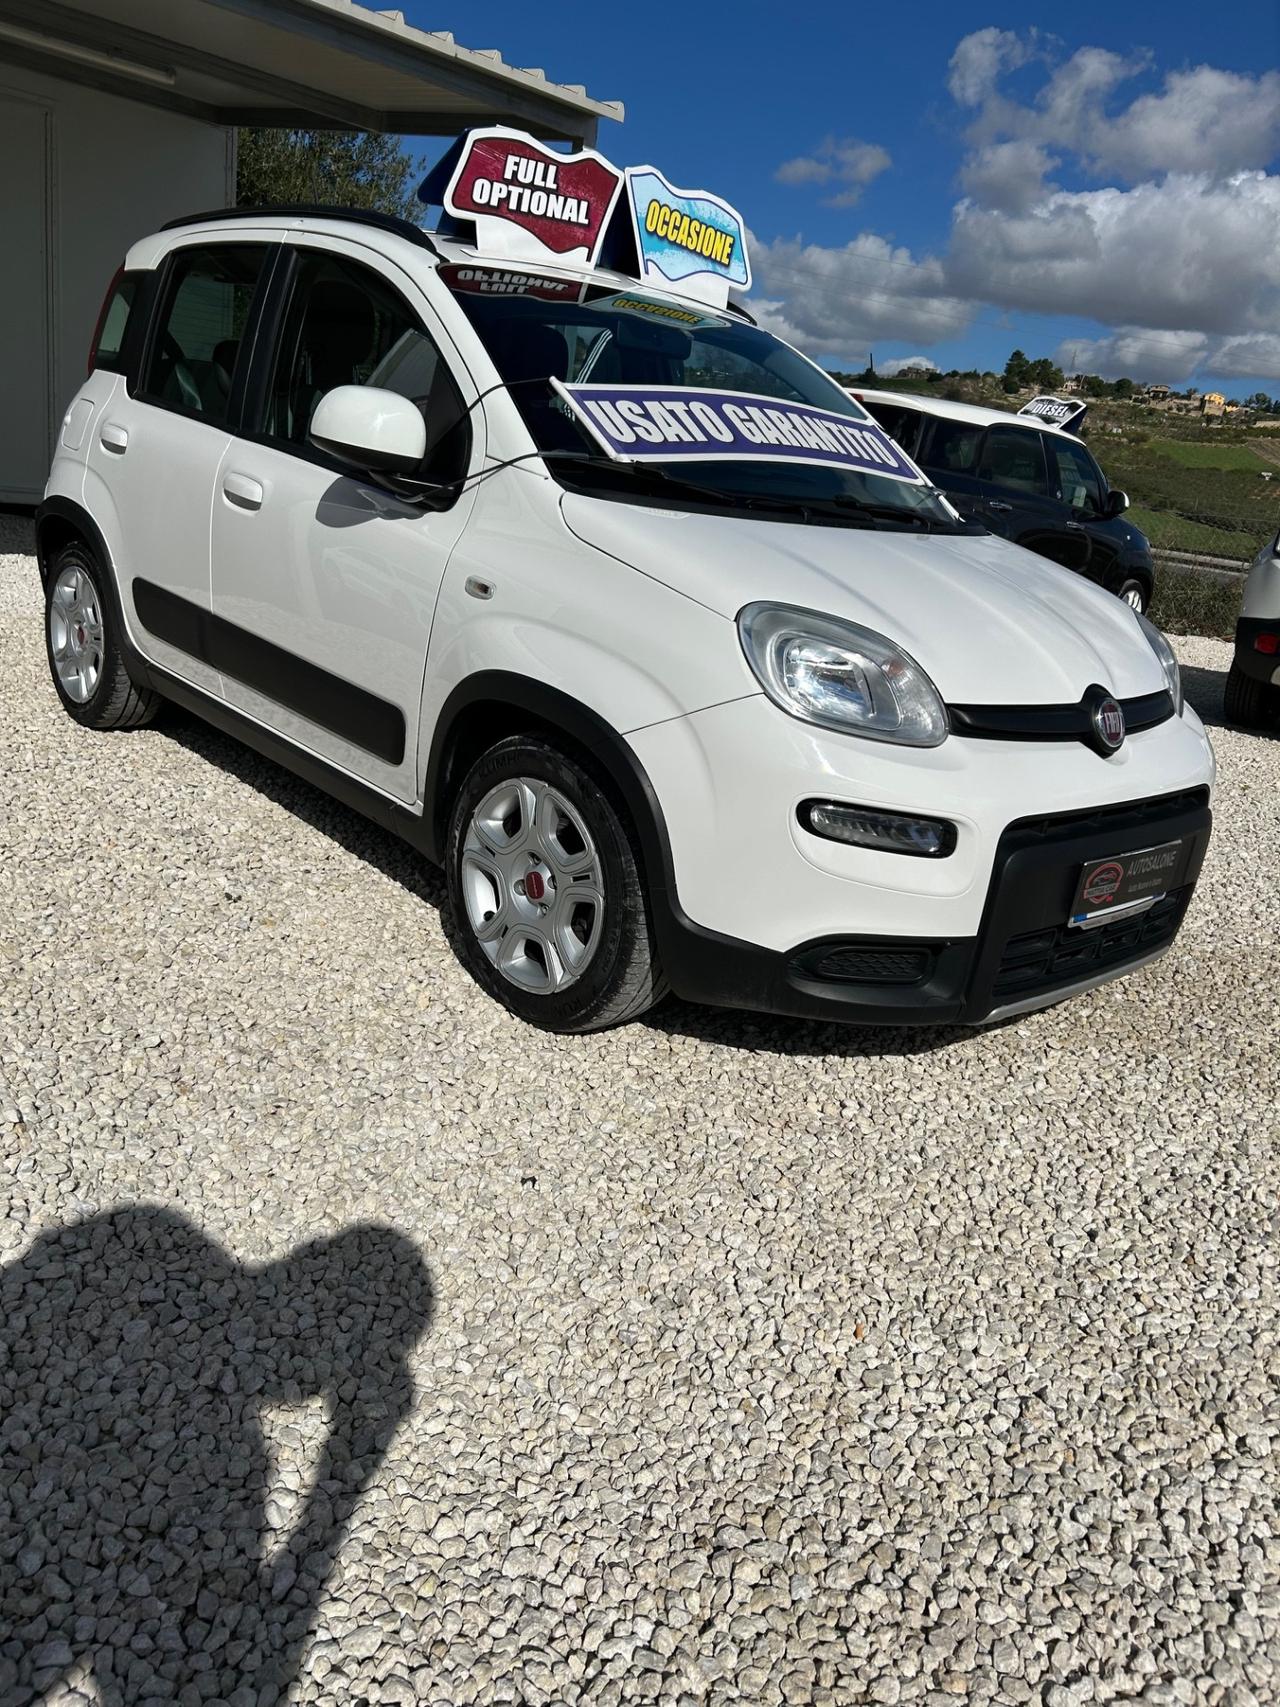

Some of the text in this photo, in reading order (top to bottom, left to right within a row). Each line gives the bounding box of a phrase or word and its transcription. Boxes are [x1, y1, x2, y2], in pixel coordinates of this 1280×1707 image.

[504, 153, 558, 190] FULL
[472, 178, 589, 225] OPTIONAL
[646, 199, 735, 267] OCCASIONE
[1032, 403, 1068, 417] DIESEL
[583, 399, 899, 469] USATO GARANTITO
[1127, 851, 1176, 875] AUTOSALONE
